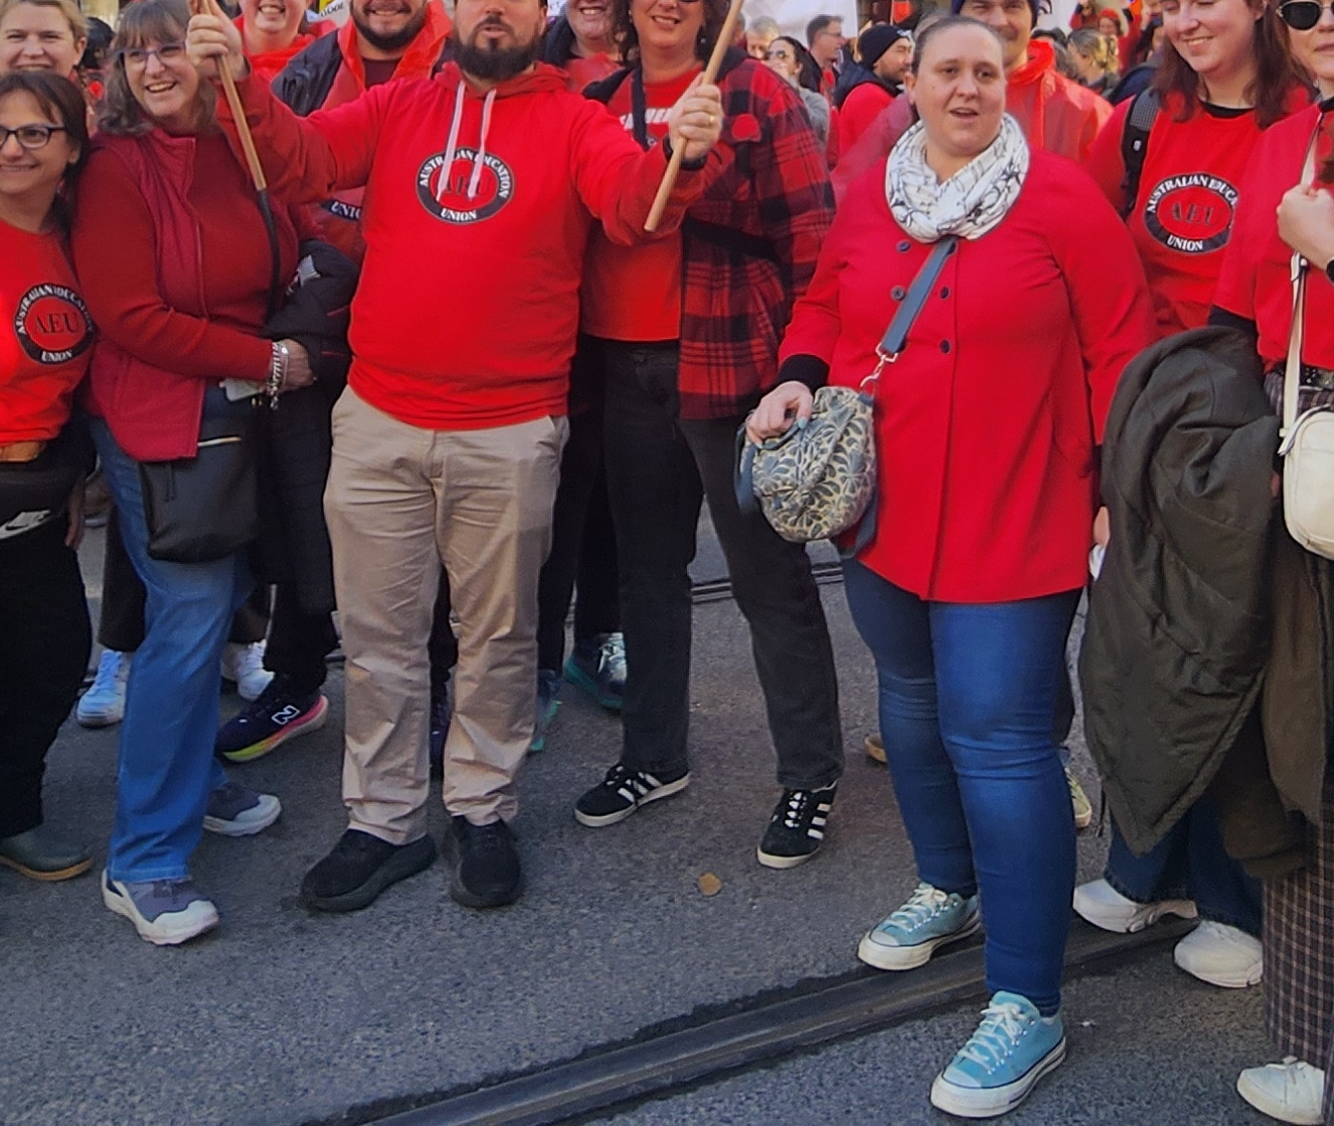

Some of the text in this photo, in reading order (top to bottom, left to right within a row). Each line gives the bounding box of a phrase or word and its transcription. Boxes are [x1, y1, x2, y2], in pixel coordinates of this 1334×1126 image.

[1147, 175, 1208, 213] AUSTRALIAN
[441, 207, 477, 222] UNION
[1167, 234, 1203, 251] UNION
[42, 350, 72, 362] UNION
